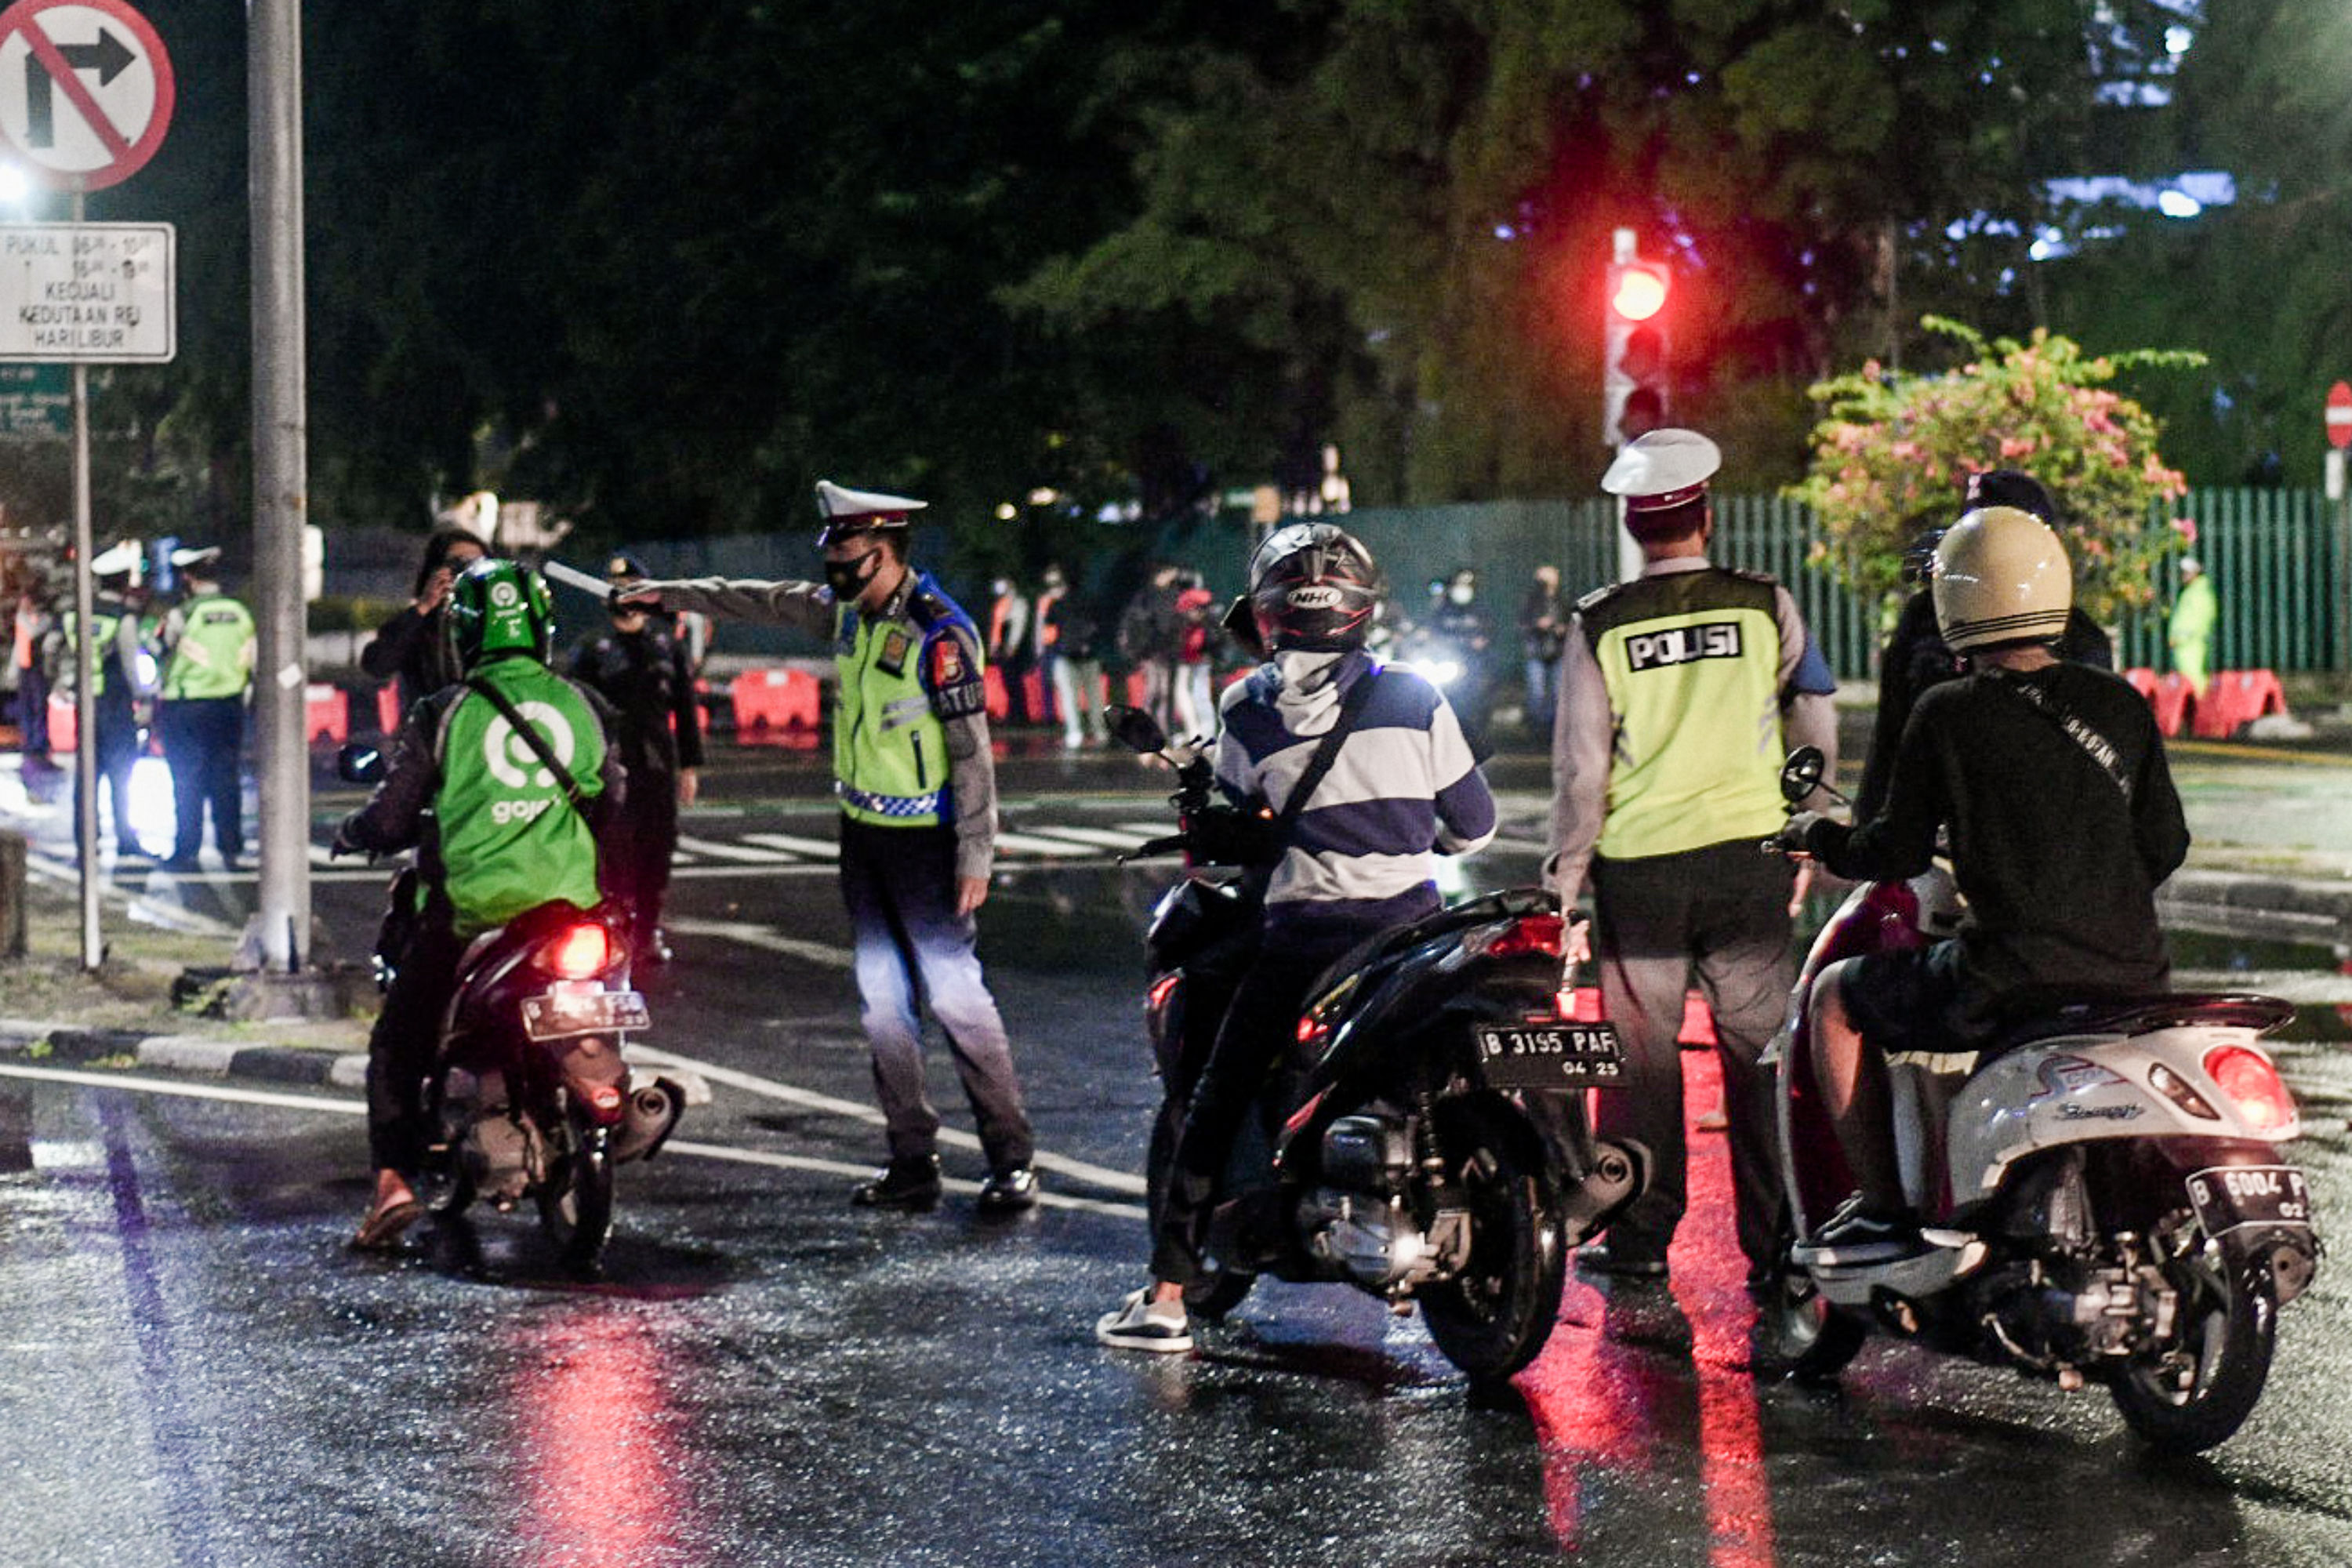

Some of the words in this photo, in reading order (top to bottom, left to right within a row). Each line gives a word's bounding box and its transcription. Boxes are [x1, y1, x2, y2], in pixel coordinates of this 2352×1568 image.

[45, 281, 115, 301] KECUALI
[19, 306, 107, 325] KEDUTAAN
[34, 329, 74, 347] HARI
[78, 329, 124, 347] LIBUR
[1628, 625, 1740, 669] POLISI
[1485, 1033, 1503, 1055] B
[1572, 1032, 1614, 1053] PAF
[1595, 1061, 1619, 1076] 25
[2191, 1178, 2211, 1207] B
